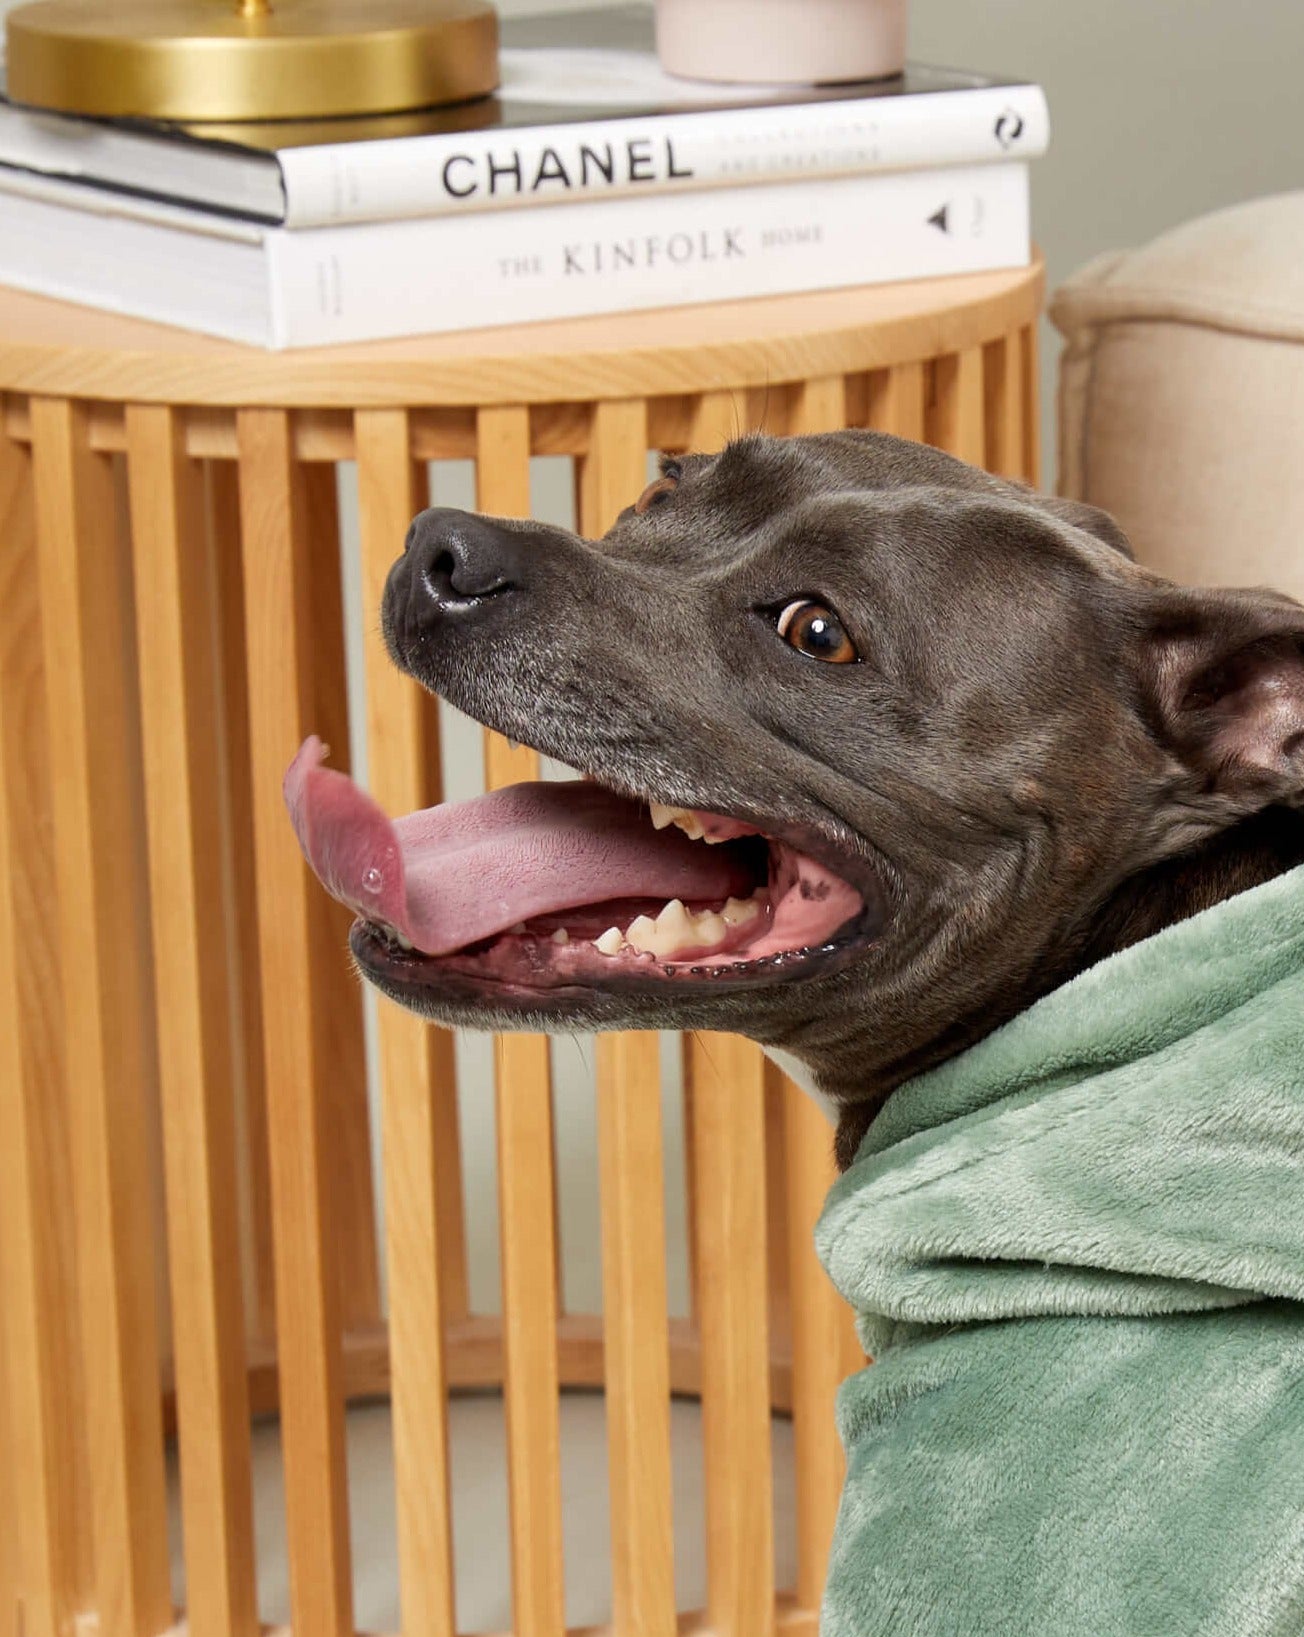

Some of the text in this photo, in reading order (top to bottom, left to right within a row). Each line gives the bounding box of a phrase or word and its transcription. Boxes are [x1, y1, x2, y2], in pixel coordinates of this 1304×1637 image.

[441, 137, 694, 198] CHANEL
[499, 254, 543, 278] THE
[563, 226, 745, 275] KINFOLK
